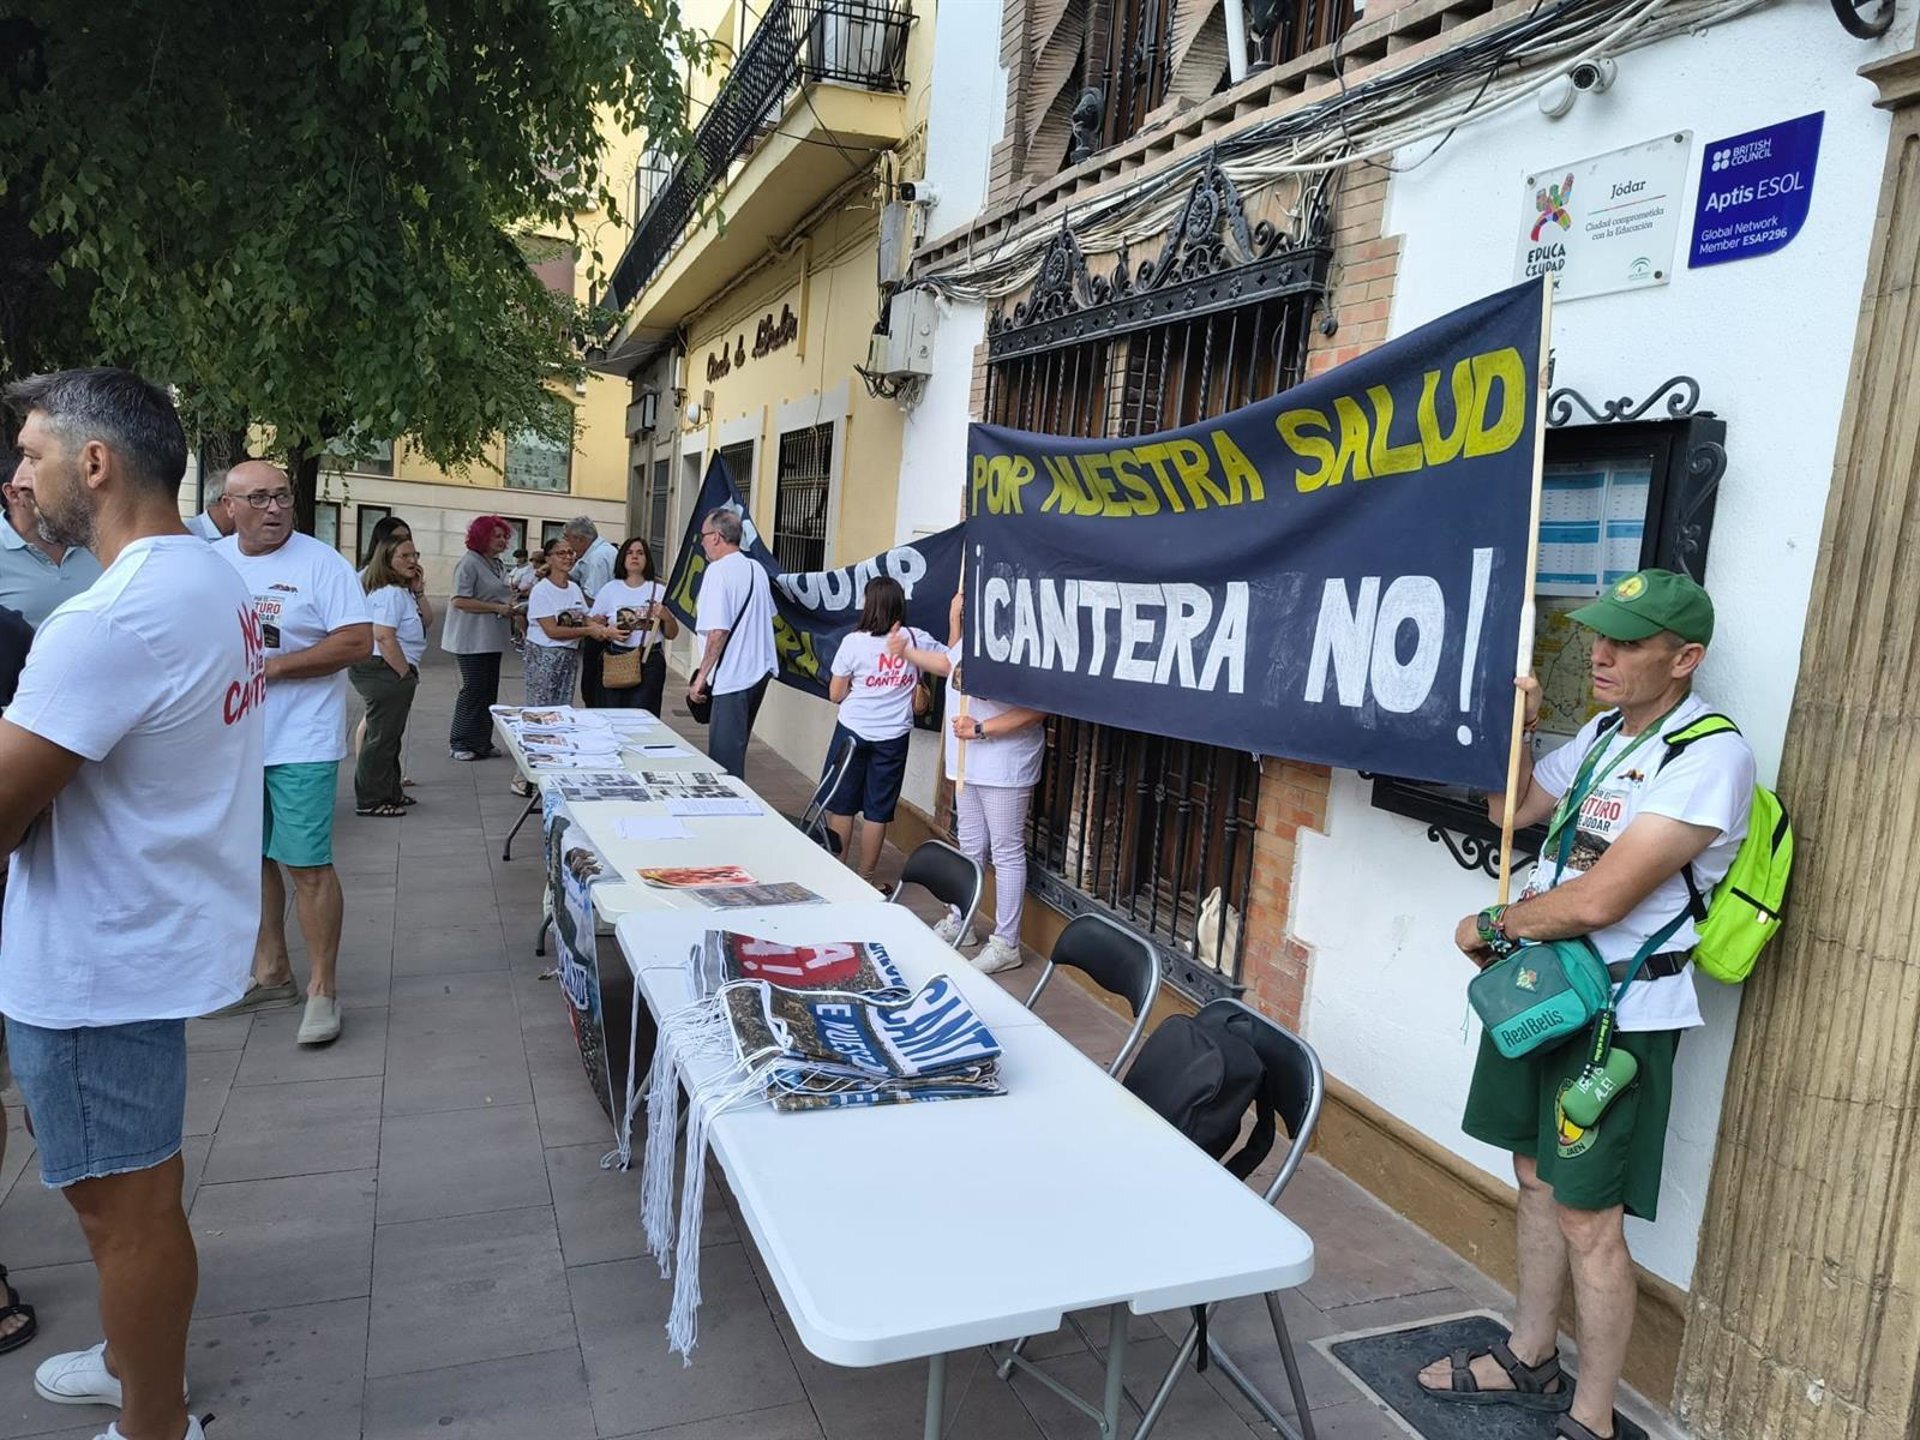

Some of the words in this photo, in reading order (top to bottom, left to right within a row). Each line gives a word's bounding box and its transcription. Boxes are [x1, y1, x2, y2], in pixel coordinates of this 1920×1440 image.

[1731, 148, 1772, 167] COUNCIL
[1733, 138, 1772, 157] BRITISH
[1610, 177, 1646, 200] Jódar
[1704, 185, 1754, 213] Aptis
[1757, 171, 1804, 200] ESOL
[1585, 219, 1612, 232] Ciudad
[1612, 206, 1665, 228] comprometida
[1701, 225, 1733, 241] Global
[1734, 215, 1778, 235] Network
[1699, 238, 1740, 254] Member
[1742, 227, 1788, 246] ESAP296
[971, 455, 1035, 516] POR
[1040, 430, 1265, 518] NUESTRA
[1276, 346, 1526, 494] SALUD
[255, 601, 281, 615] TURO
[236, 602, 263, 670] NO
[879, 652, 905, 672] NO
[865, 673, 914, 688] CANTERA
[1581, 797, 1621, 821] TURO
